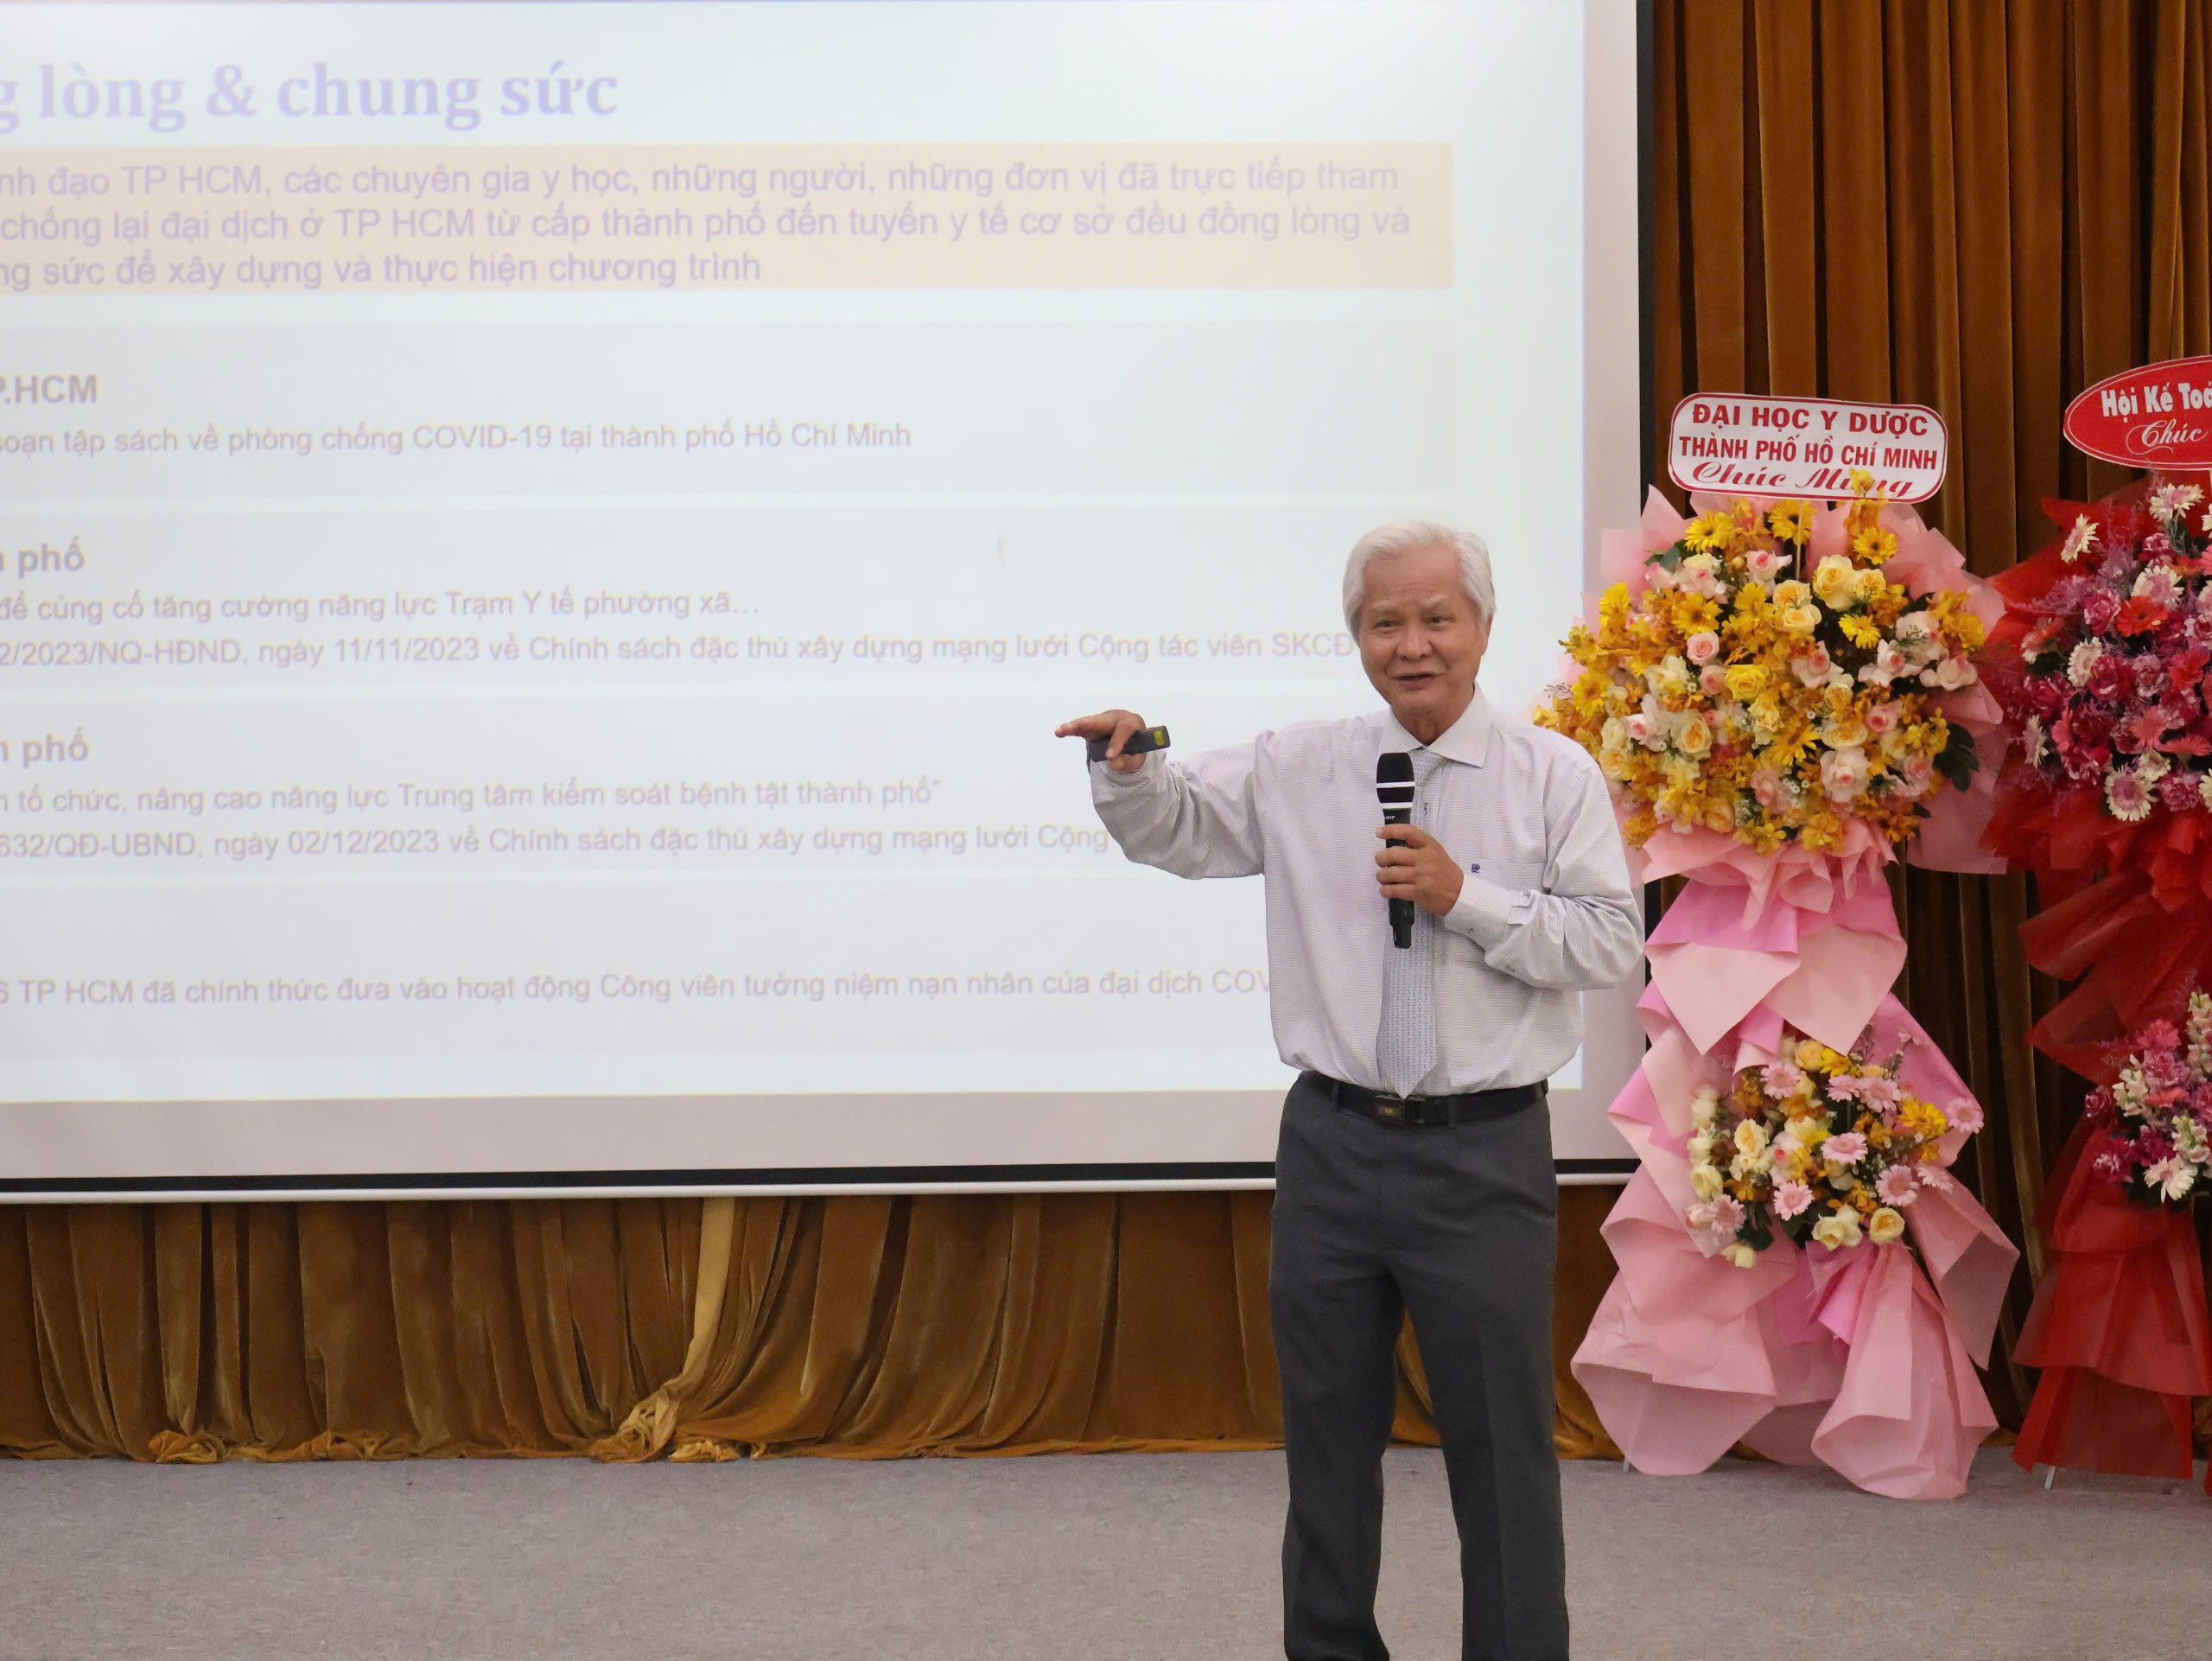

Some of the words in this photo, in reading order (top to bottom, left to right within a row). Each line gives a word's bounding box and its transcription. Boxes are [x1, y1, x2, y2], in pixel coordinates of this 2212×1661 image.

[41, 63, 186, 133] lòng
[207, 65, 257, 118] &
[277, 62, 481, 131] chung
[500, 60, 617, 116] sức
[48, 166, 110, 200] đạo
[121, 165, 167, 194] TP
[180, 164, 270, 198] HCM,
[284, 164, 341, 194] các
[353, 163, 470, 200] chuyên
[482, 163, 530, 200] gia
[543, 169, 560, 200] y
[571, 163, 638, 197] học,
[652, 162, 757, 199] những
[769, 162, 874, 198] người,
[888, 161, 993, 197] những
[1005, 162, 1069, 190] đơn
[1080, 162, 1106, 194] vị
[1118, 162, 1158, 190] đã
[1170, 162, 1236, 194] trực
[1248, 156, 1306, 196] tiếp
[1318, 162, 1398, 189] tham
[0, 205, 101, 247] chống
[114, 210, 149, 245] lại
[161, 210, 209, 243] đại
[221, 209, 289, 244] dịch
[334, 208, 381, 238] TP
[392, 207, 474, 238] HCM
[486, 207, 521, 237] từ
[531, 201, 591, 244] cấp
[601, 207, 693, 237] thành
[706, 200, 766, 242] phố
[777, 200, 836, 236] đến
[849, 200, 938, 242] tuyến
[950, 213, 968, 242] y
[978, 200, 1009, 235] tế
[1020, 213, 1062, 235] cơ
[1126, 200, 1186, 235] đều
[1198, 200, 1279, 241] đồng
[1293, 206, 1359, 241] lòng
[1372, 206, 1410, 234] và
[43, 256, 105, 285] sức
[168, 255, 226, 291] xây
[236, 254, 322, 291] dựng
[334, 253, 372, 283] và
[383, 253, 459, 289] thực
[469, 252, 537, 288] hiện
[549, 252, 677, 289] chương
[688, 251, 760, 281] trình
[1693, 404, 1740, 429] ĐẠI
[1751, 407, 1809, 432] HỌC
[1821, 410, 1838, 430] Y
[1849, 411, 1928, 439] DƯỢC
[2101, 387, 2139, 423] Hội
[2144, 383, 2174, 413] Kế
[63, 430, 105, 458] tập
[114, 428, 178, 452] sách
[187, 422, 219, 451] về
[228, 428, 312, 456] phòng
[321, 421, 403, 456] chống
[412, 424, 552, 449] COVID-19
[560, 424, 592, 453] tại
[601, 424, 677, 449] thành
[685, 418, 735, 454] phố
[791, 423, 836, 448] Chí
[847, 423, 911, 447] Minh
[1679, 433, 1748, 459] THÀNH
[1755, 434, 1800, 461] PHỐ
[1805, 436, 1834, 463] HỒ
[1841, 442, 1878, 466] CHÍ
[1884, 449, 1937, 469] MINH
[2126, 419, 2209, 455] Chúc
[1693, 461, 1788, 487] Chúc
[18, 536, 85, 580] phố
[112, 589, 144, 620] cố
[153, 595, 212, 624] tăng
[220, 595, 309, 622] cường
[319, 594, 385, 622] năng
[395, 592, 436, 620] lực
[444, 590, 513, 620] Trạm
[522, 590, 542, 614] Y
[550, 585, 574, 614] tế
[584, 590, 690, 620] phường
[258, 640, 324, 669] ngày
[334, 636, 479, 663] 11/11/2023
[488, 633, 519, 661] về
[529, 636, 608, 660] Chính
[618, 636, 681, 659] sách
[690, 636, 739, 664] đặc
[798, 635, 844, 664] xây
[853, 634, 923, 664] dựng
[932, 640, 1007, 664] mạng
[1016, 633, 1069, 658] lưới
[1078, 633, 1149, 664] Cộng
[1159, 634, 1198, 658] tác
[1207, 633, 1262, 657] viên
[22, 726, 89, 769] phố
[52, 788, 127, 815] chức,
[137, 787, 204, 817] nâng
[213, 791, 262, 810] cao
[271, 786, 338, 815] năng
[346, 785, 389, 812] lực
[397, 783, 474, 813] Trung
[483, 784, 532, 807] tâm
[614, 782, 671, 805] soát
[680, 781, 746, 809] bệnh
[755, 781, 788, 809] tật
[797, 780, 872, 805] thành
[214, 832, 279, 862] ngày
[288, 829, 439, 855] 02/12/2023
[448, 824, 480, 853] về
[489, 828, 569, 852] Chính
[578, 827, 640, 851] sách
[650, 827, 698, 856] đặc
[758, 827, 804, 856] xây
[812, 826, 883, 856] dựng
[892, 830, 967, 855] mạng
[976, 824, 1028, 849] lưới
[1038, 824, 1109, 854] Cộng
[18, 979, 55, 1004] TP
[65, 979, 133, 1004] HCM
[143, 980, 175, 1003] đã
[185, 979, 258, 1003] chính
[268, 978, 328, 1002] thức
[337, 977, 390, 1001] đưa
[399, 978, 448, 1000] vào
[457, 976, 515, 1004] hoạt
[524, 975, 590, 1003] động
[600, 974, 671, 1003] Công
[680, 974, 734, 997] viên
[744, 972, 824, 1002] tưởng
[835, 972, 899, 1000] niệm
[909, 977, 957, 1000] nạn
[967, 971, 1033, 995] nhân
[1042, 971, 1090, 995] của
[1099, 971, 1139, 999] đại
[1147, 971, 1202, 999] dịch
